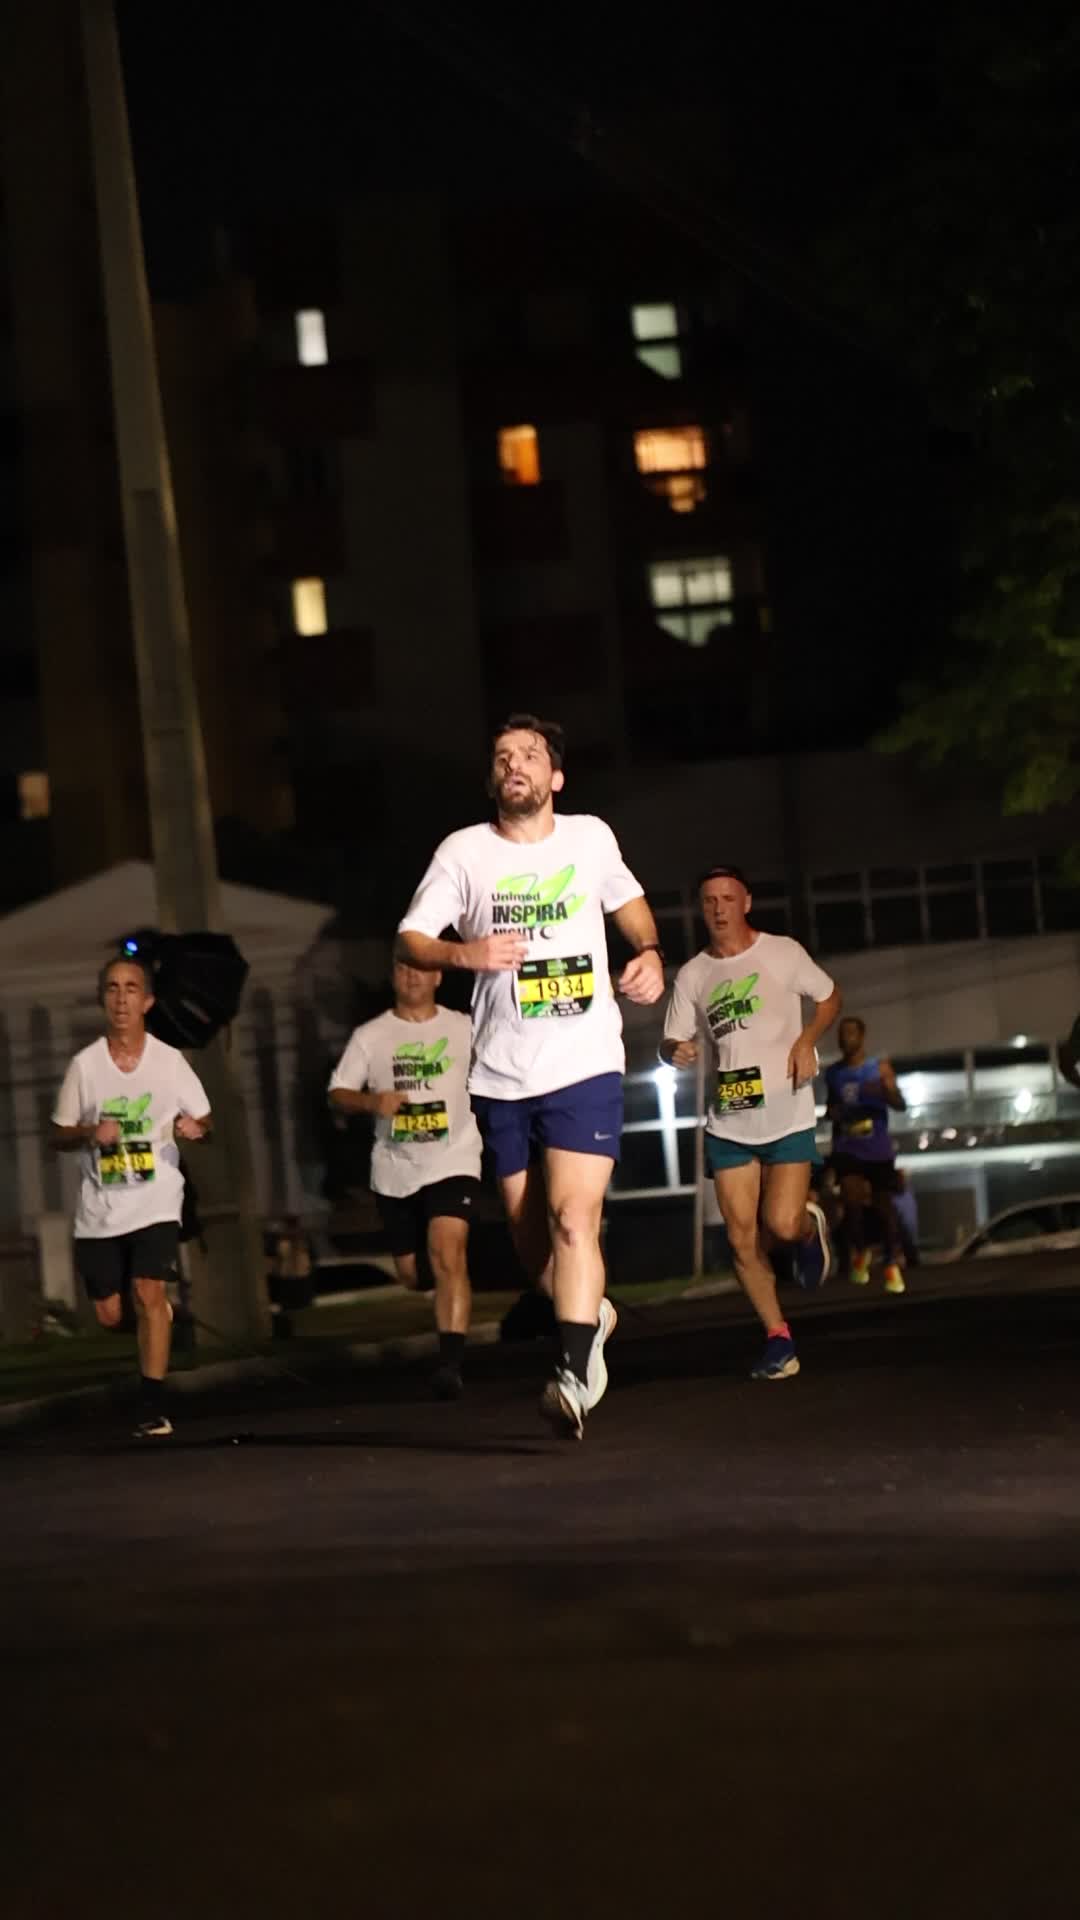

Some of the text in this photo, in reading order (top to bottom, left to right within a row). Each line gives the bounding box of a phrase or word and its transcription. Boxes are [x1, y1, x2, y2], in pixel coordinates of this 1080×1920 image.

[491, 890, 541, 902] Unimed
[492, 901, 568, 924] INSPIRA
[536, 975, 584, 1000] 1934
[719, 1081, 755, 1098] 2505
[403, 1113, 439, 1130] 1245
